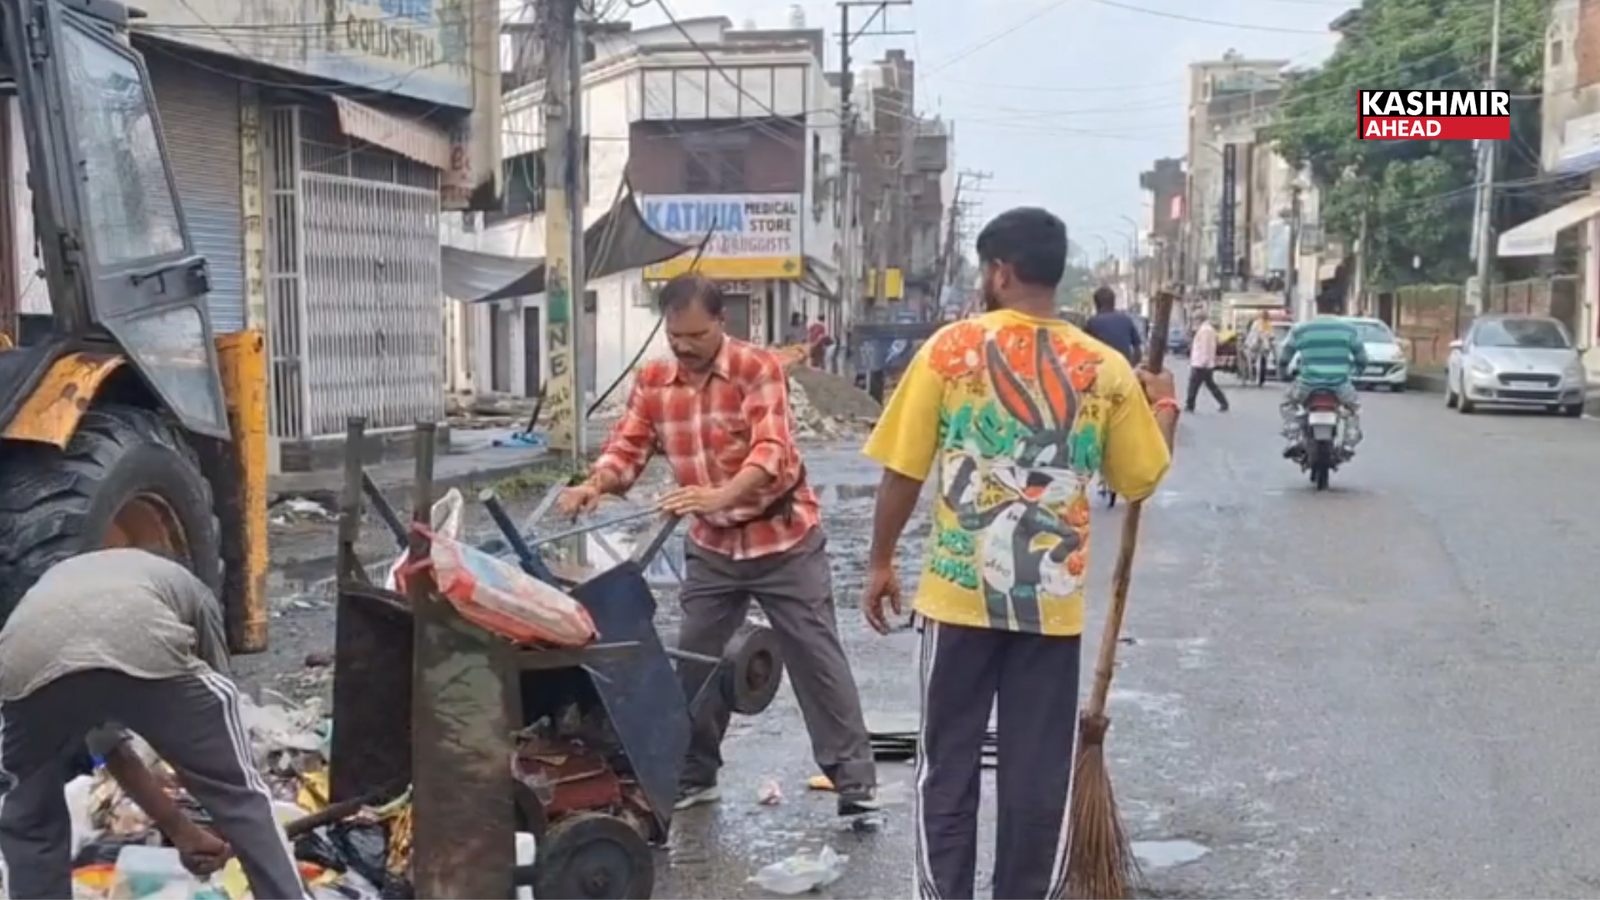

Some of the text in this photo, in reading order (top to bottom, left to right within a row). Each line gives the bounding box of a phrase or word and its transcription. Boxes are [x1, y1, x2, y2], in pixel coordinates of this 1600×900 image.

[346, 16, 435, 68] GOLDSMITH
[646, 201, 797, 231] KATHUA MEDICAL
[750, 218, 792, 232] STORE
